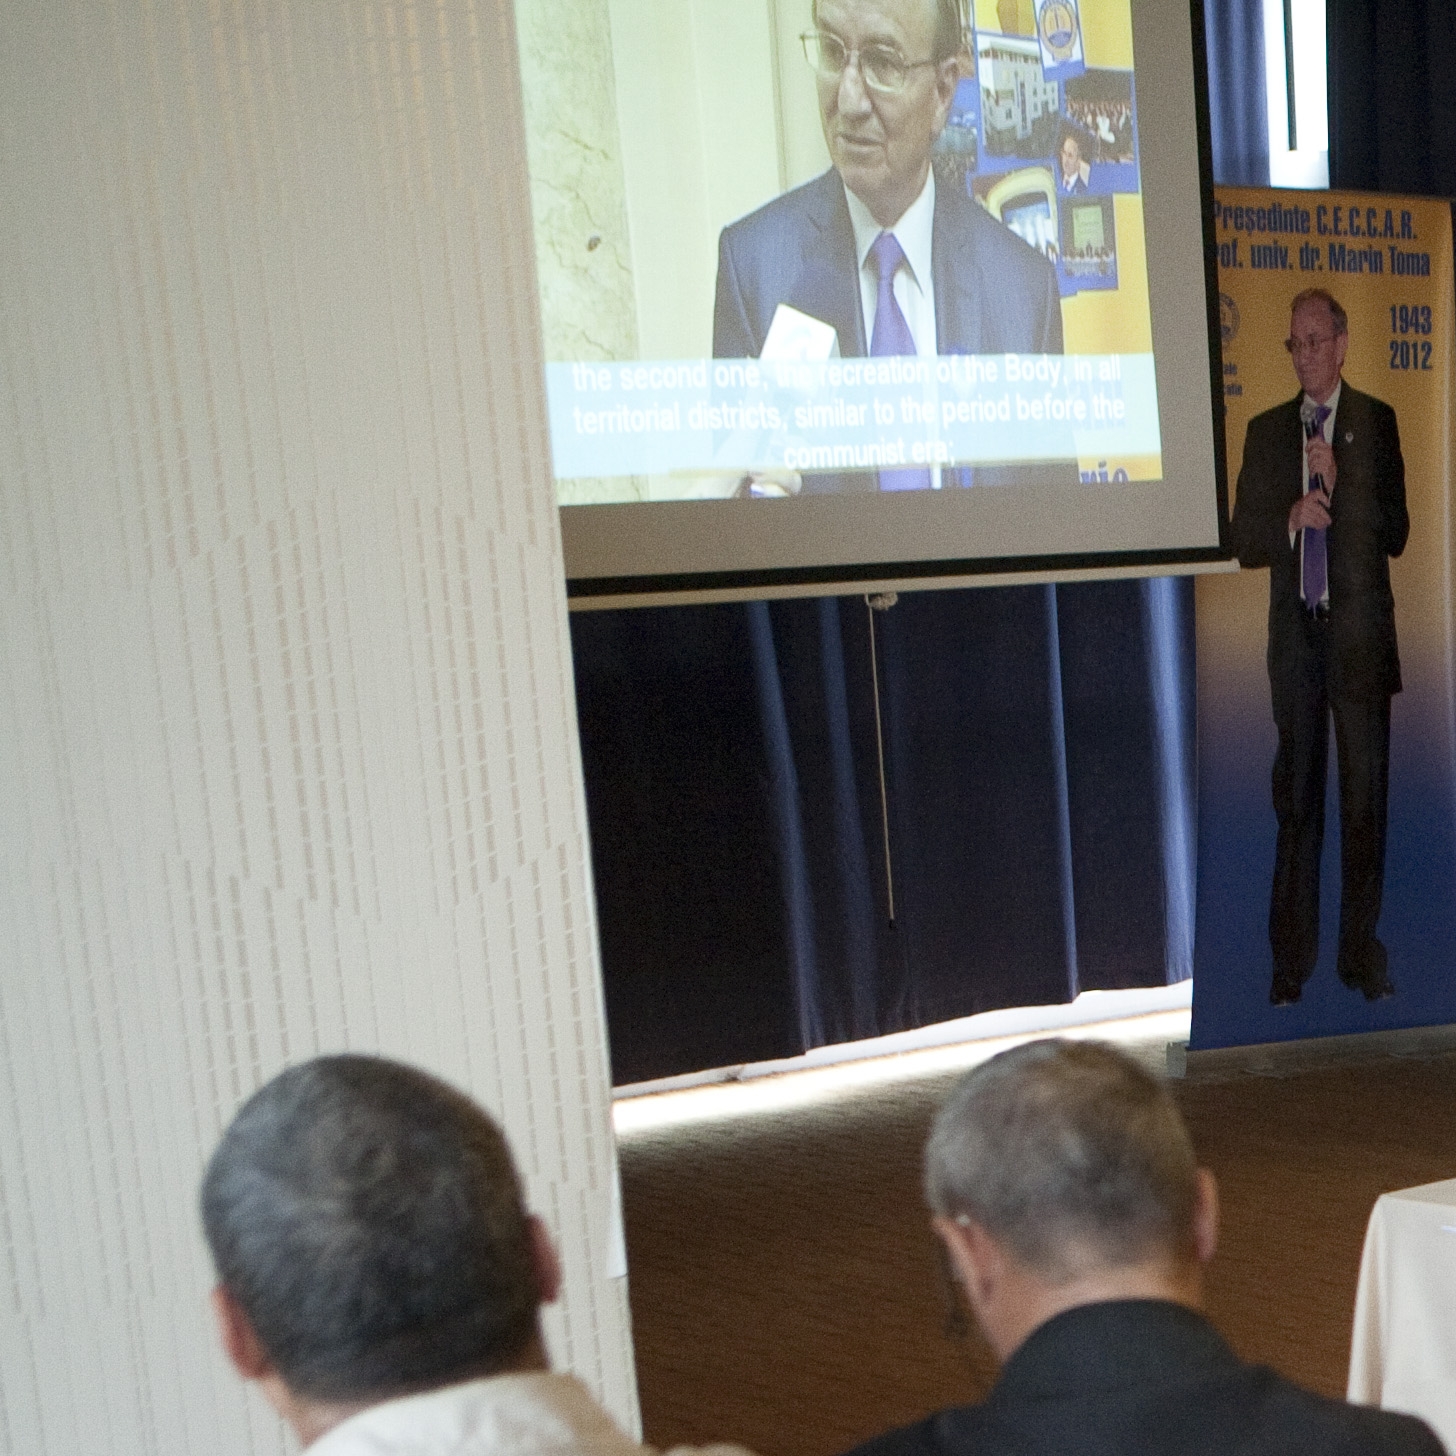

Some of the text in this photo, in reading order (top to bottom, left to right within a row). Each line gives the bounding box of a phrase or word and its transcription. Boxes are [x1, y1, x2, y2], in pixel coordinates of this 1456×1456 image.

[1316, 204, 1417, 240] C.E.C.C.A.R.
[1251, 239, 1294, 270] univ.
[1299, 241, 1322, 271] dr.
[1328, 242, 1383, 274] Marin
[1388, 245, 1430, 277] Toma
[1389, 303, 1432, 335] 1943
[572, 360, 612, 391] the
[619, 358, 707, 390] second
[714, 364, 769, 391] one,
[818, 357, 930, 387] recreation
[937, 355, 960, 383] of
[964, 356, 998, 382] the
[1004, 354, 1068, 388] Body,
[1075, 353, 1092, 381] in
[1099, 353, 1121, 380] all
[1390, 340, 1432, 371] 2012
[572, 402, 680, 434] territorial
[688, 400, 788, 432] districts,
[795, 398, 868, 429] similar
[874, 398, 895, 426] to
[901, 395, 935, 423] the
[942, 393, 1011, 431] period
[1017, 391, 1086, 421] before
[1093, 392, 1125, 420] the
[783, 437, 956, 470] communist era;
